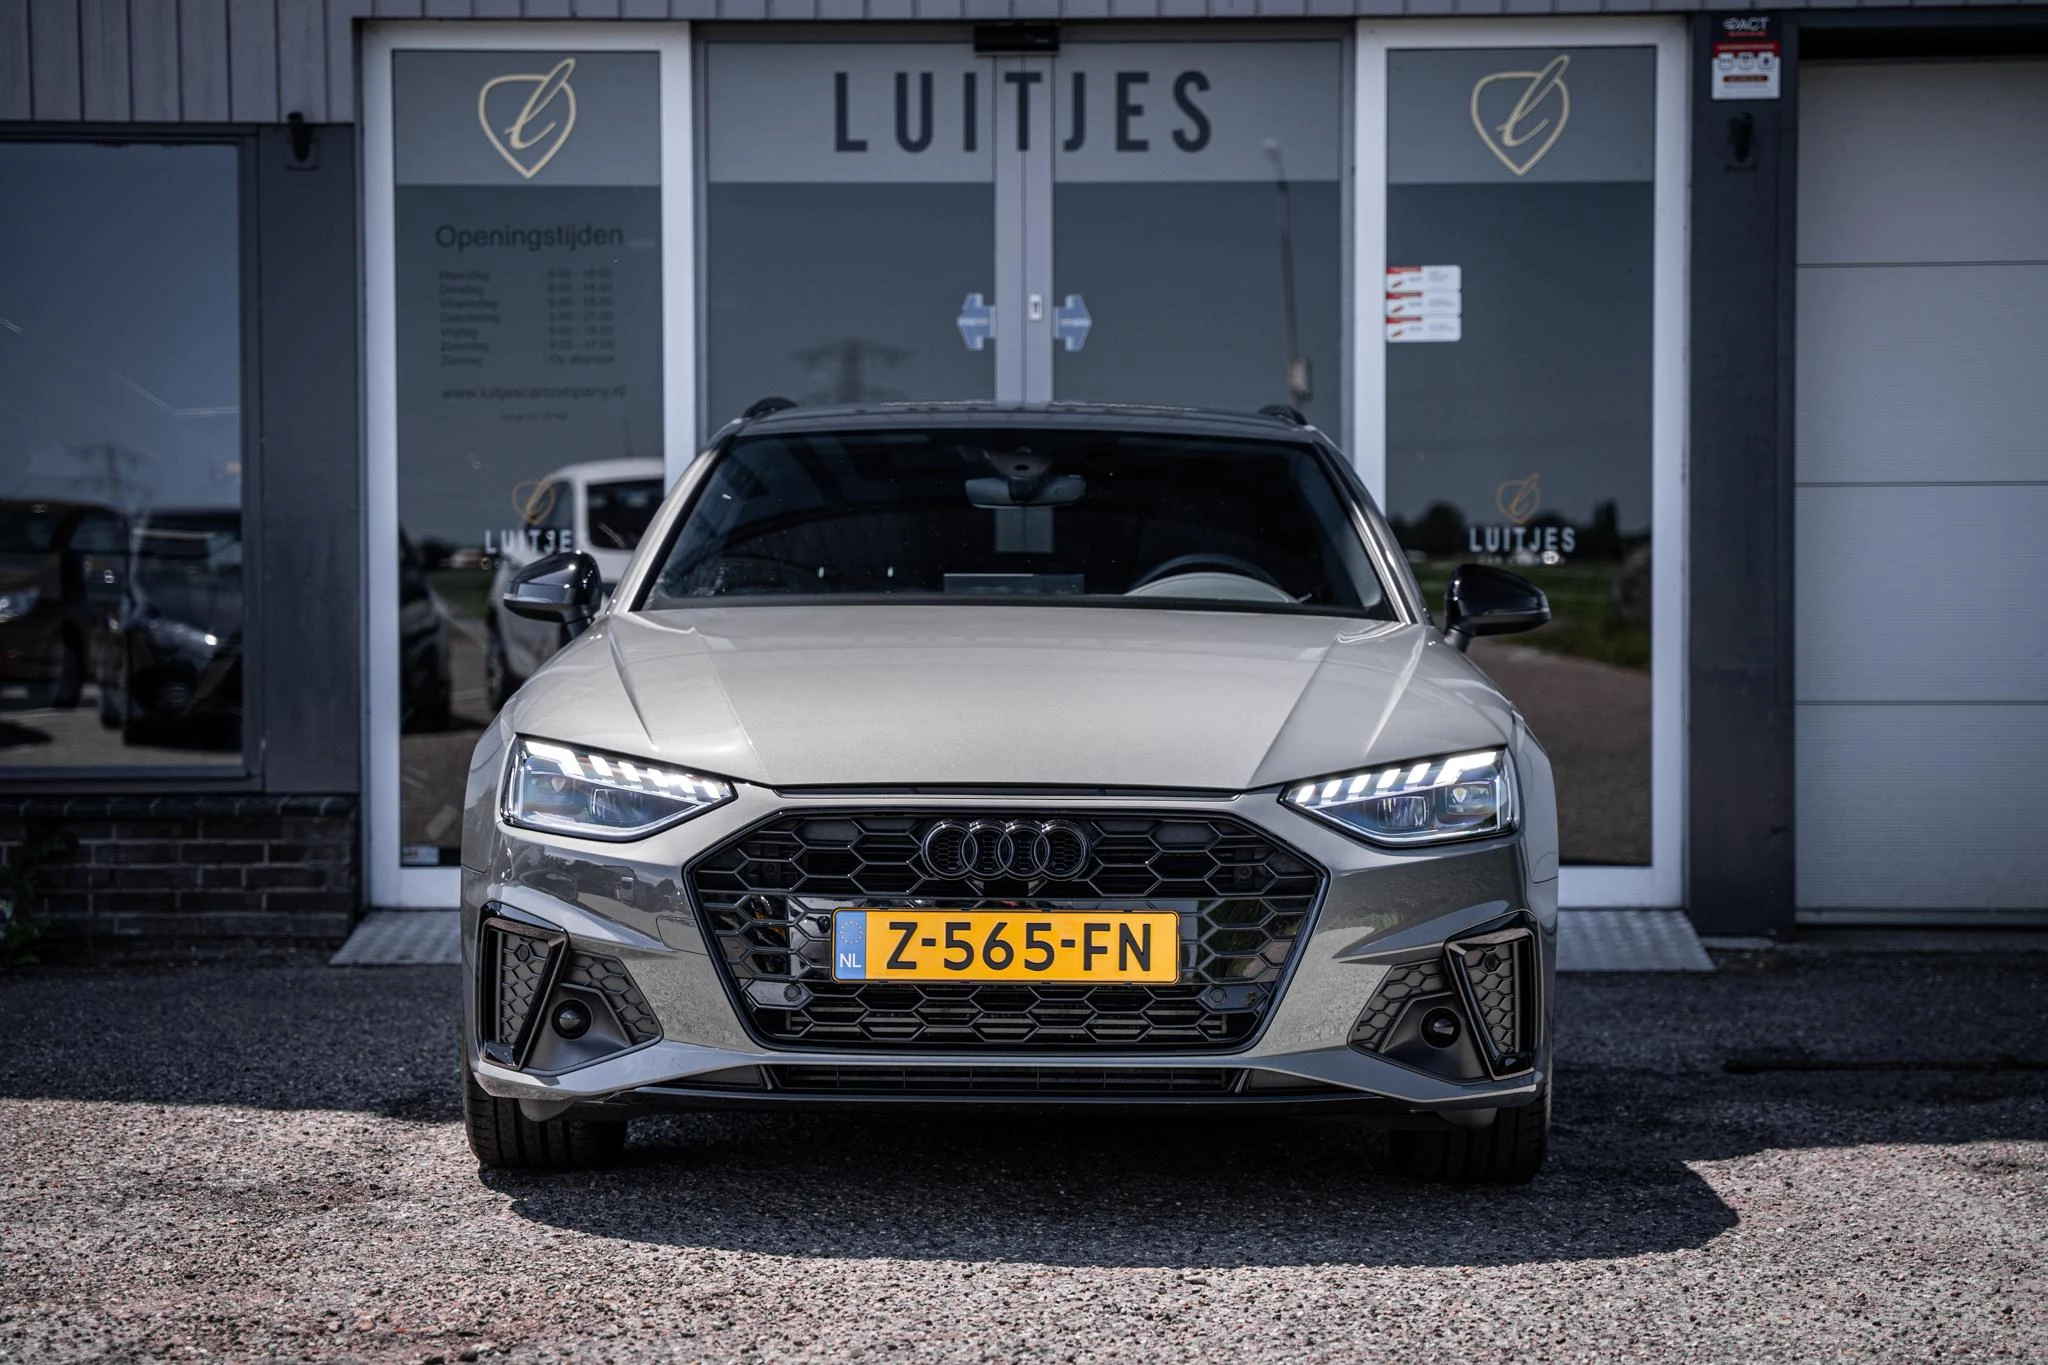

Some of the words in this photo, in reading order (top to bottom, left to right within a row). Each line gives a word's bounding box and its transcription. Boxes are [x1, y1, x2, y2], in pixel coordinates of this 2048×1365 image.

[834, 70, 1212, 153] LUITJES
[435, 223, 625, 254] Openingstijden
[485, 529, 573, 554] LUITJE
[1469, 526, 1576, 553] LUITJES
[839, 952, 862, 969] NL
[886, 920, 1151, 972] Z-565-FN
